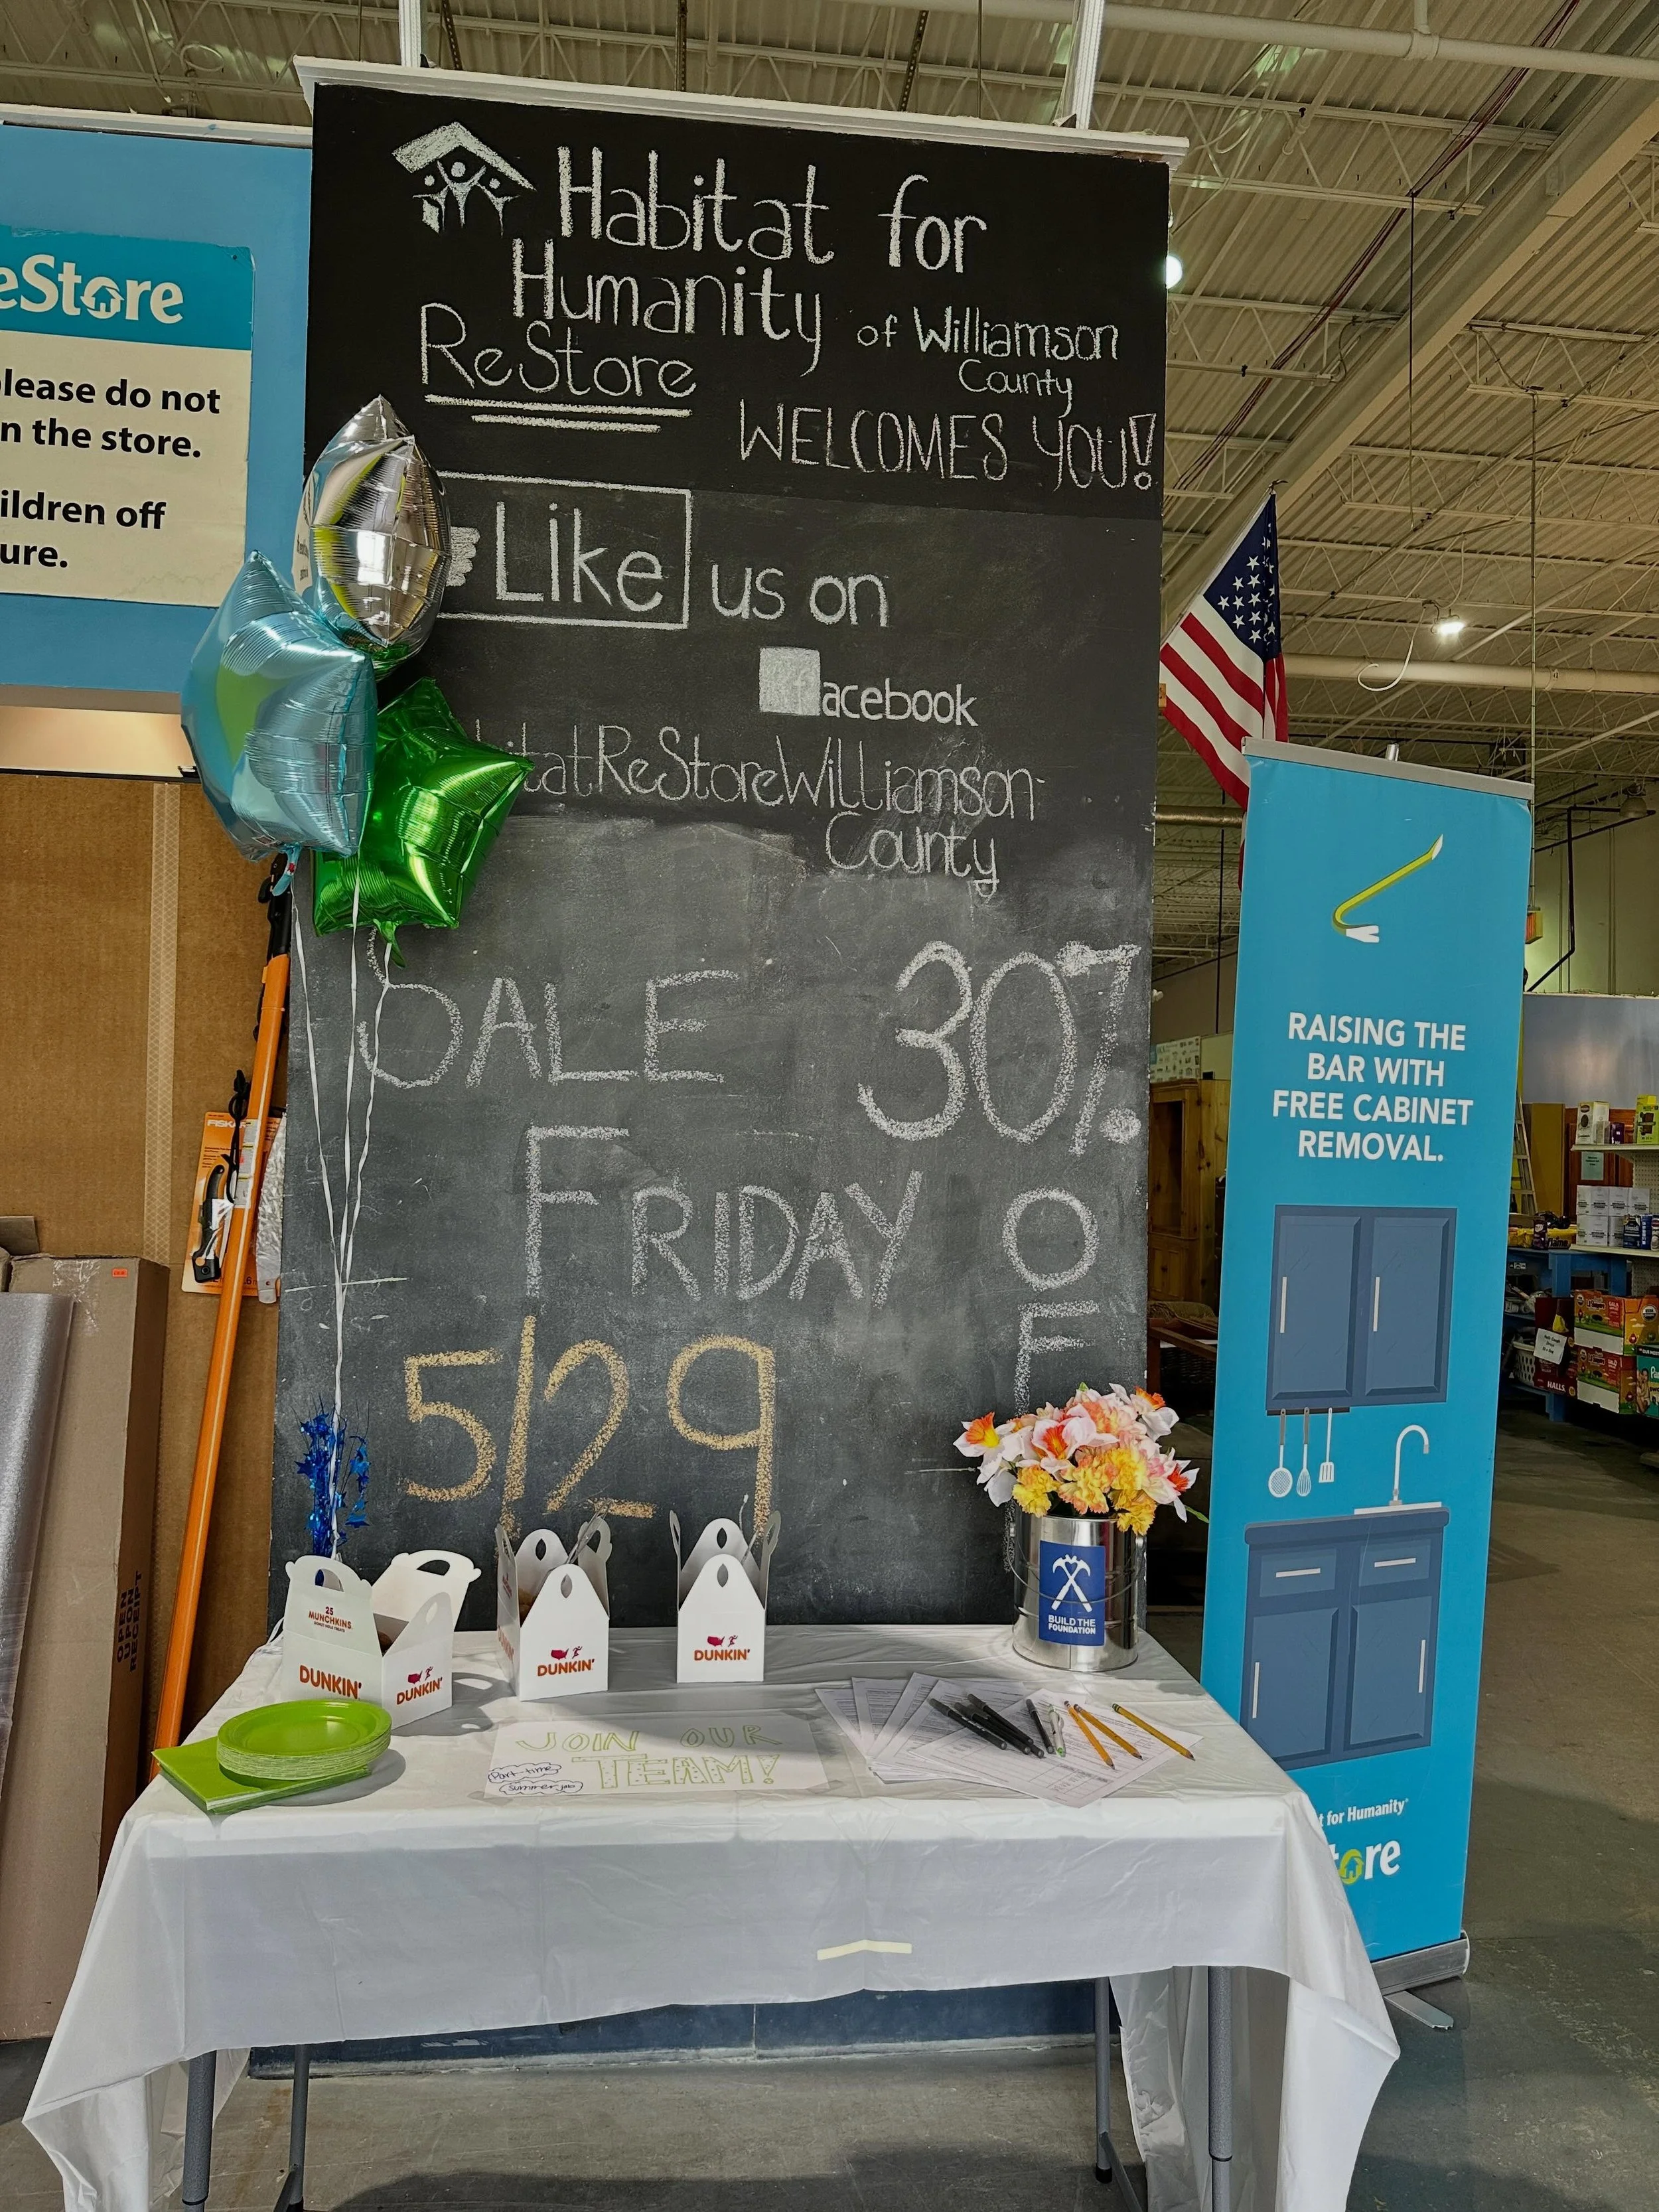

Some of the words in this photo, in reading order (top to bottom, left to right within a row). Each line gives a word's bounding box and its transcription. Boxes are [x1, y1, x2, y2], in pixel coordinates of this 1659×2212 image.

[557, 145, 835, 265] Habitat
[877, 173, 987, 273] for
[512, 237, 822, 378] Humanity
[421, 302, 697, 398] ReStore
[857, 314, 898, 348] of
[912, 305, 1119, 361] Williamson
[0, 368, 96, 404] lease
[105, 378, 151, 409] do
[161, 388, 221, 415] not
[959, 359, 1073, 418] County
[32, 417, 92, 449] the
[101, 427, 202, 458] store.
[740, 398, 1009, 482] WELCOMES
[1032, 413, 1157, 491] YOU!
[0, 490, 106, 526] ildren
[115, 501, 167, 530] off
[496, 500, 664, 613] Like
[711, 564, 787, 621] us
[809, 573, 889, 627] on
[825, 810, 999, 897] County
[356, 928, 741, 1089] SALE
[857, 939, 1142, 1157] 30%
[1288, 1011, 1406, 1047] RAISING
[1414, 1021, 1467, 1051] THE
[1307, 1052, 1366, 1083] BAR
[1373, 1056, 1445, 1087] WITH
[1272, 1089, 1344, 1120] FREE
[1352, 1093, 1474, 1126] CABINET
[1298, 1130, 1444, 1162] REMOVAL.
[525, 1126, 924, 1308] FRIDAY
[403, 1315, 776, 1540] 5/29
[117, 1591, 127, 1662] OPEN
[123, 1587, 134, 1659] UPON
[129, 1570, 142, 1673] RECEIPT
[308, 1611, 352, 1629] MUNCHKINS
[325, 1606, 334, 1615] 25
[1048, 1614, 1076, 1626] BUILD
[1077, 1617, 1096, 1627] THE
[1048, 1623, 1096, 1635] FOUNDATION
[537, 1658, 595, 1677] DUNKIN'
[693, 1649, 751, 1661] DUNKIN'
[299, 1664, 362, 1700] DUNKIN'
[396, 1676, 443, 1706] DUNKIN'
[516, 1730, 640, 1751] JOIN
[680, 1725, 782, 1748] OUR
[571, 1753, 780, 1789] TEAM!
[1327, 1810, 1345, 1826] for
[1347, 1799, 1406, 1822] Humanity
